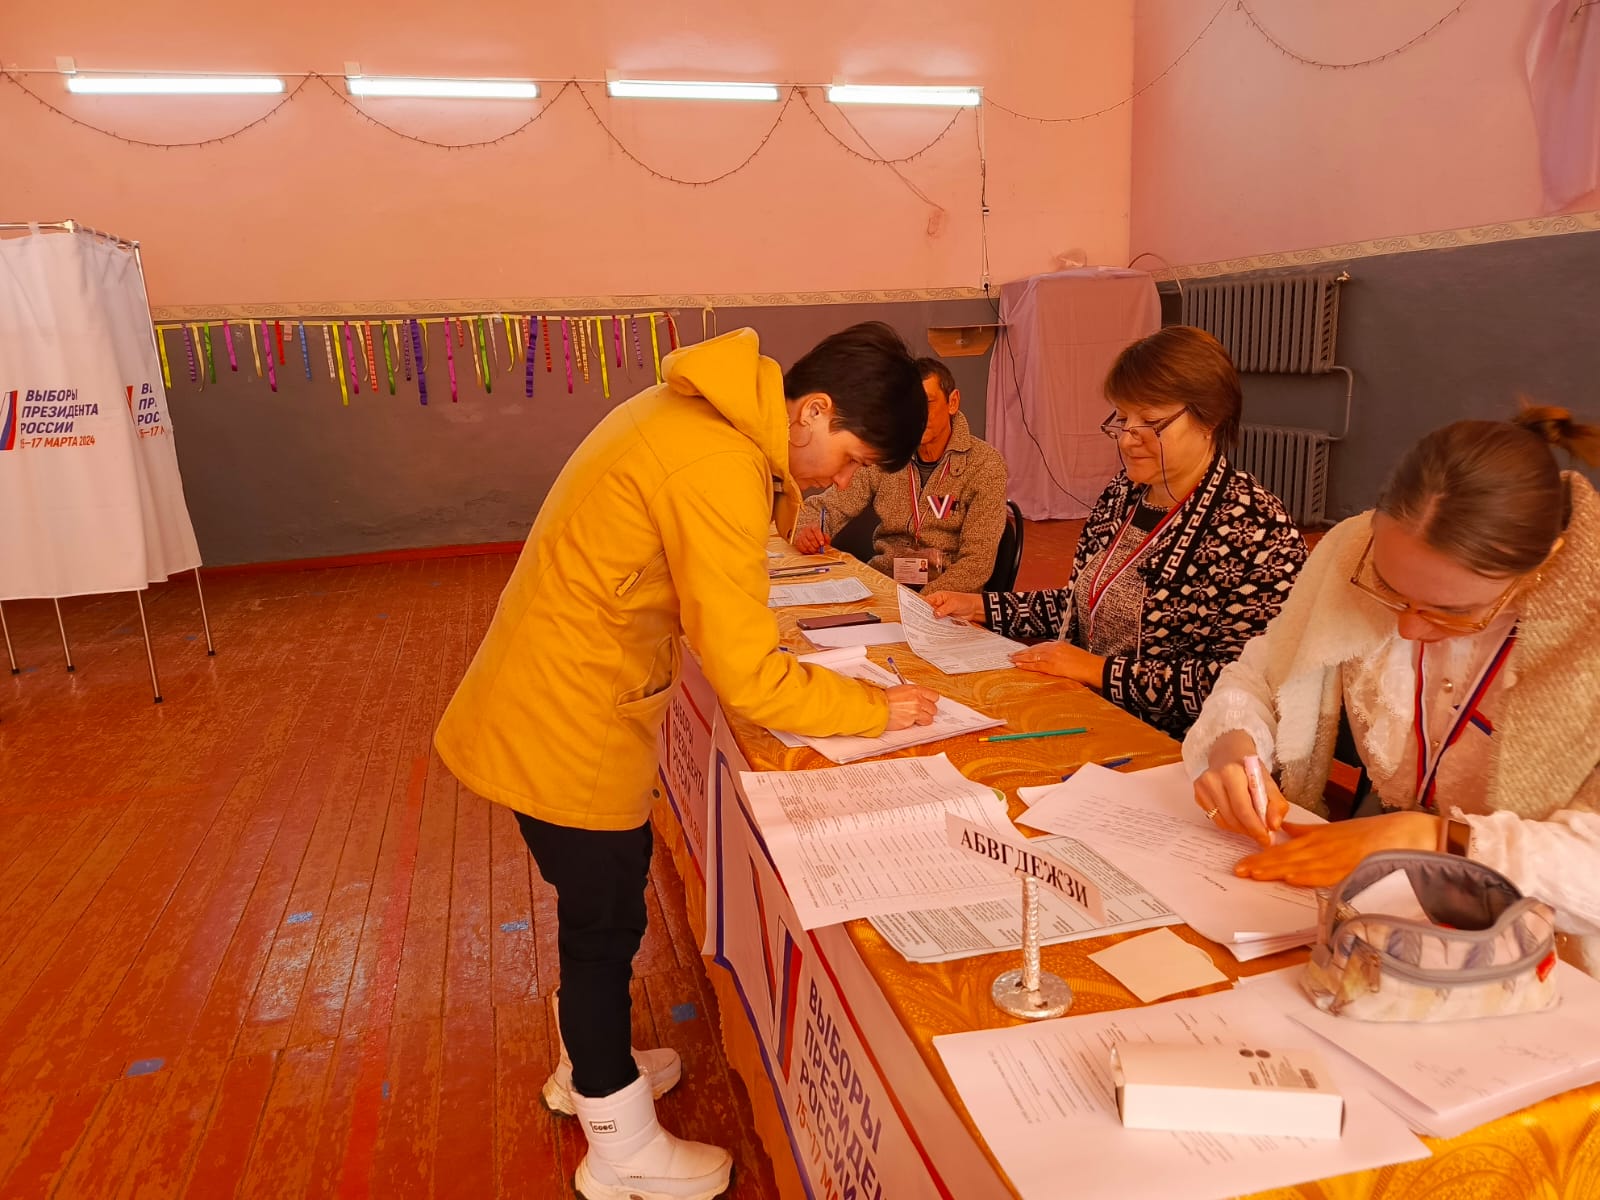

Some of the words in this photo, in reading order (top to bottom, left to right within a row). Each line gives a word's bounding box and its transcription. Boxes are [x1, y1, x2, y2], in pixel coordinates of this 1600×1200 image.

[25, 389, 78, 402] ВЫБОРЫ
[21, 403, 98, 419] ПРЕЗИДЕНТА
[20, 422, 74, 435] РОССИИ
[44, 436, 78, 448] МАРТА
[79, 435, 96, 446] 2024
[808, 976, 882, 1154] ВЫБОРЫ
[820, 1161, 839, 1200] М
